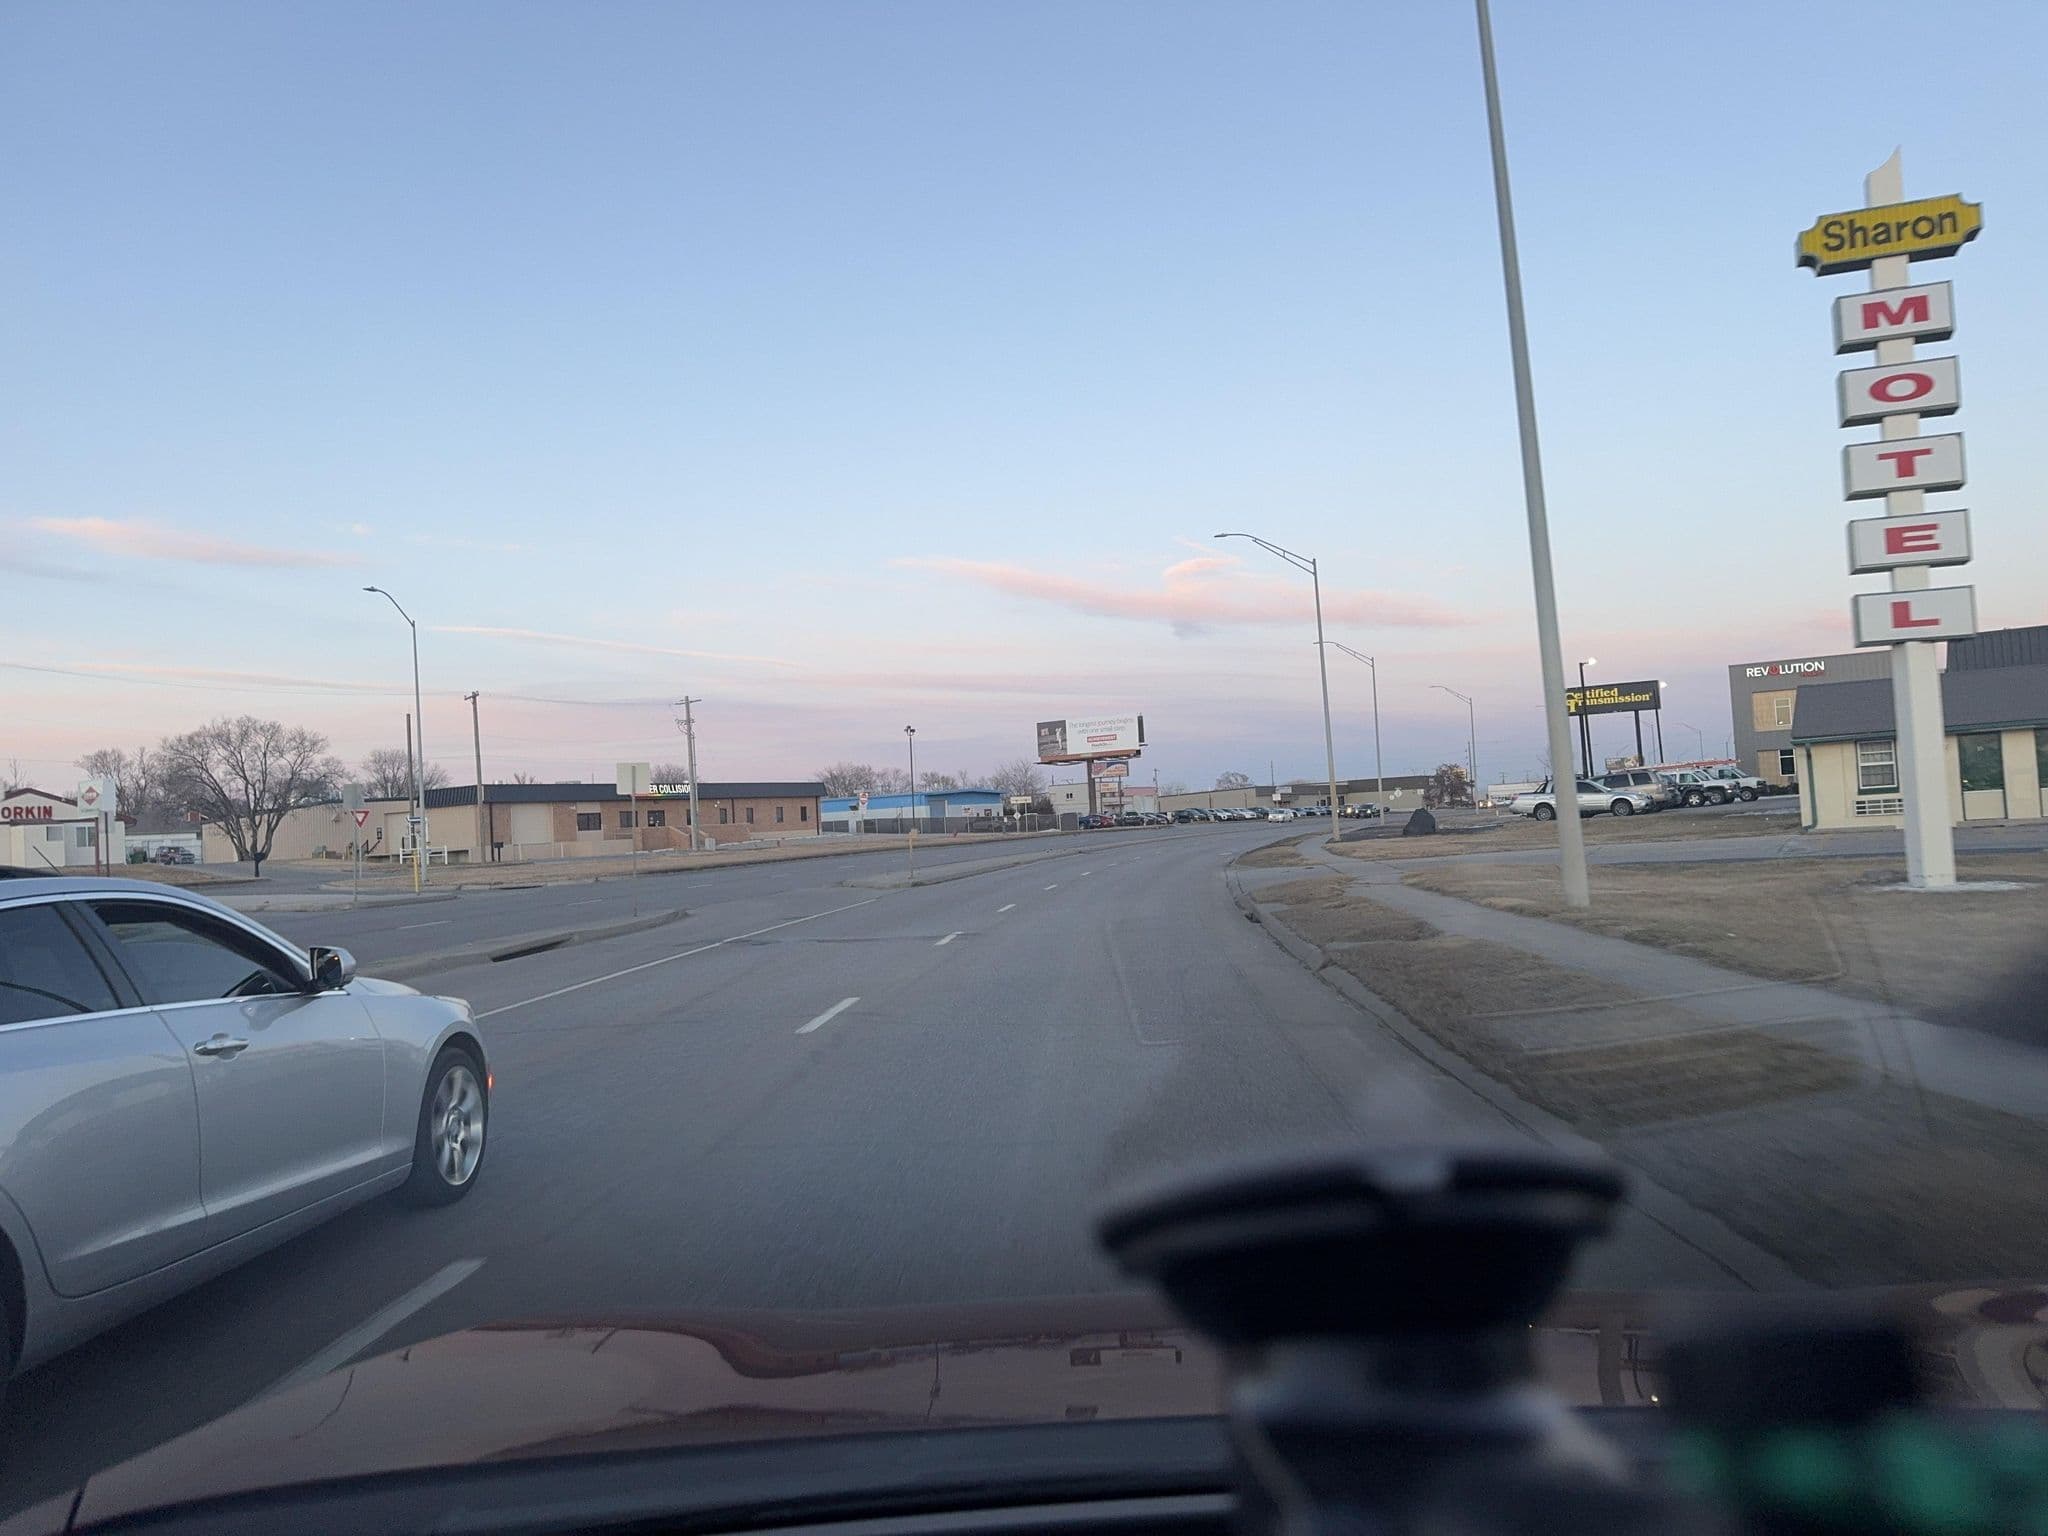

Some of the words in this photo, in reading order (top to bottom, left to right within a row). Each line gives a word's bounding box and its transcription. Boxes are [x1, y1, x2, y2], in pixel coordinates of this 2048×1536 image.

[1822, 209, 1958, 252] Sharon
[1861, 294, 1941, 629] MOTEL
[1565, 688, 1618, 700] Cetified
[1, 806, 53, 819] ORKIN
